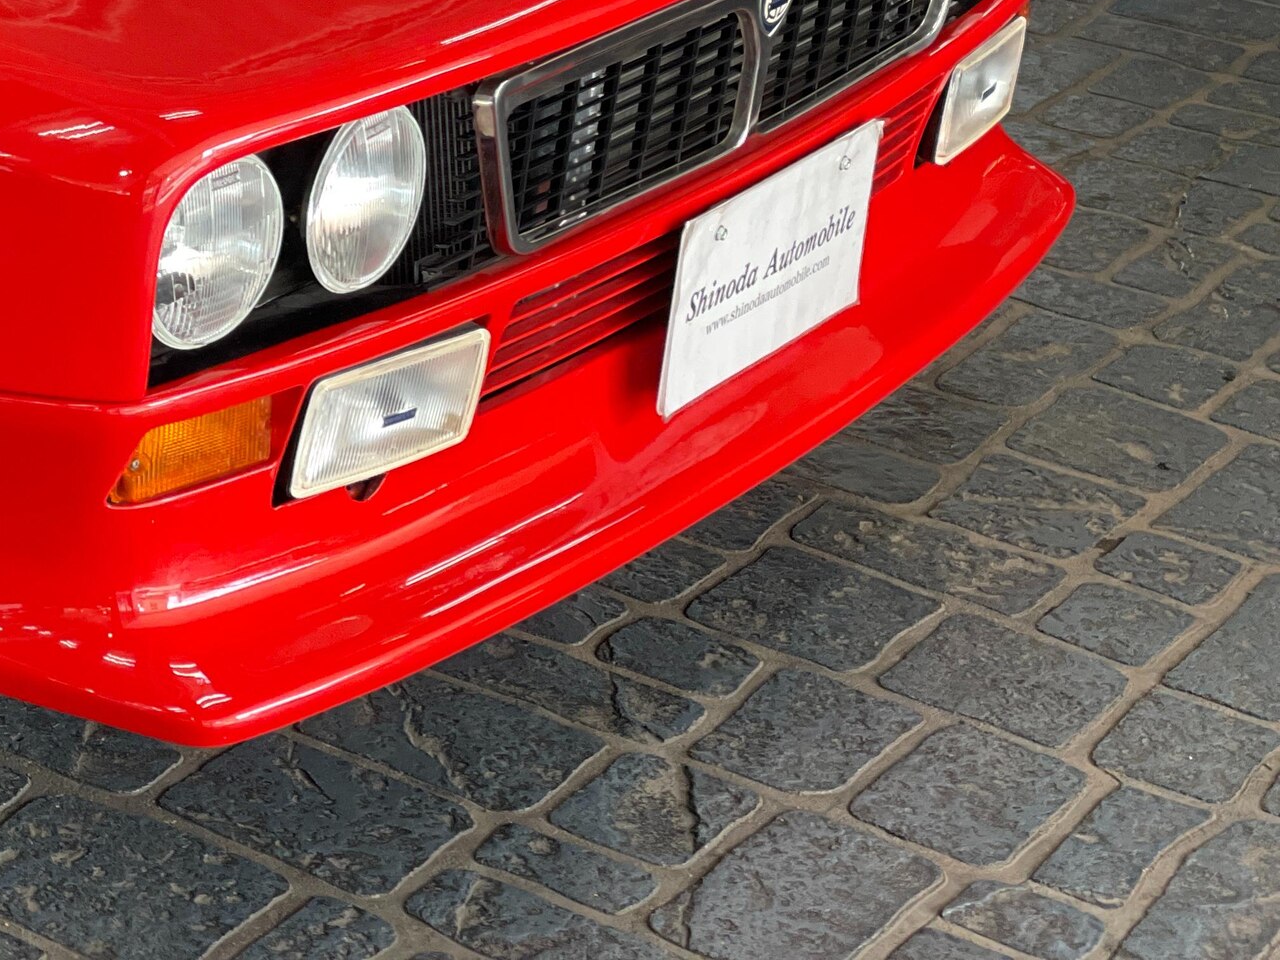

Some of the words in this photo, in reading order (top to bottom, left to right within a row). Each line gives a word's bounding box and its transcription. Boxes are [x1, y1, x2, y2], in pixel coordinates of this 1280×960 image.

[685, 262, 760, 324] Shinoda
[762, 205, 856, 280] Automobile
[705, 255, 831, 336] www.shinodaautomobile.com
